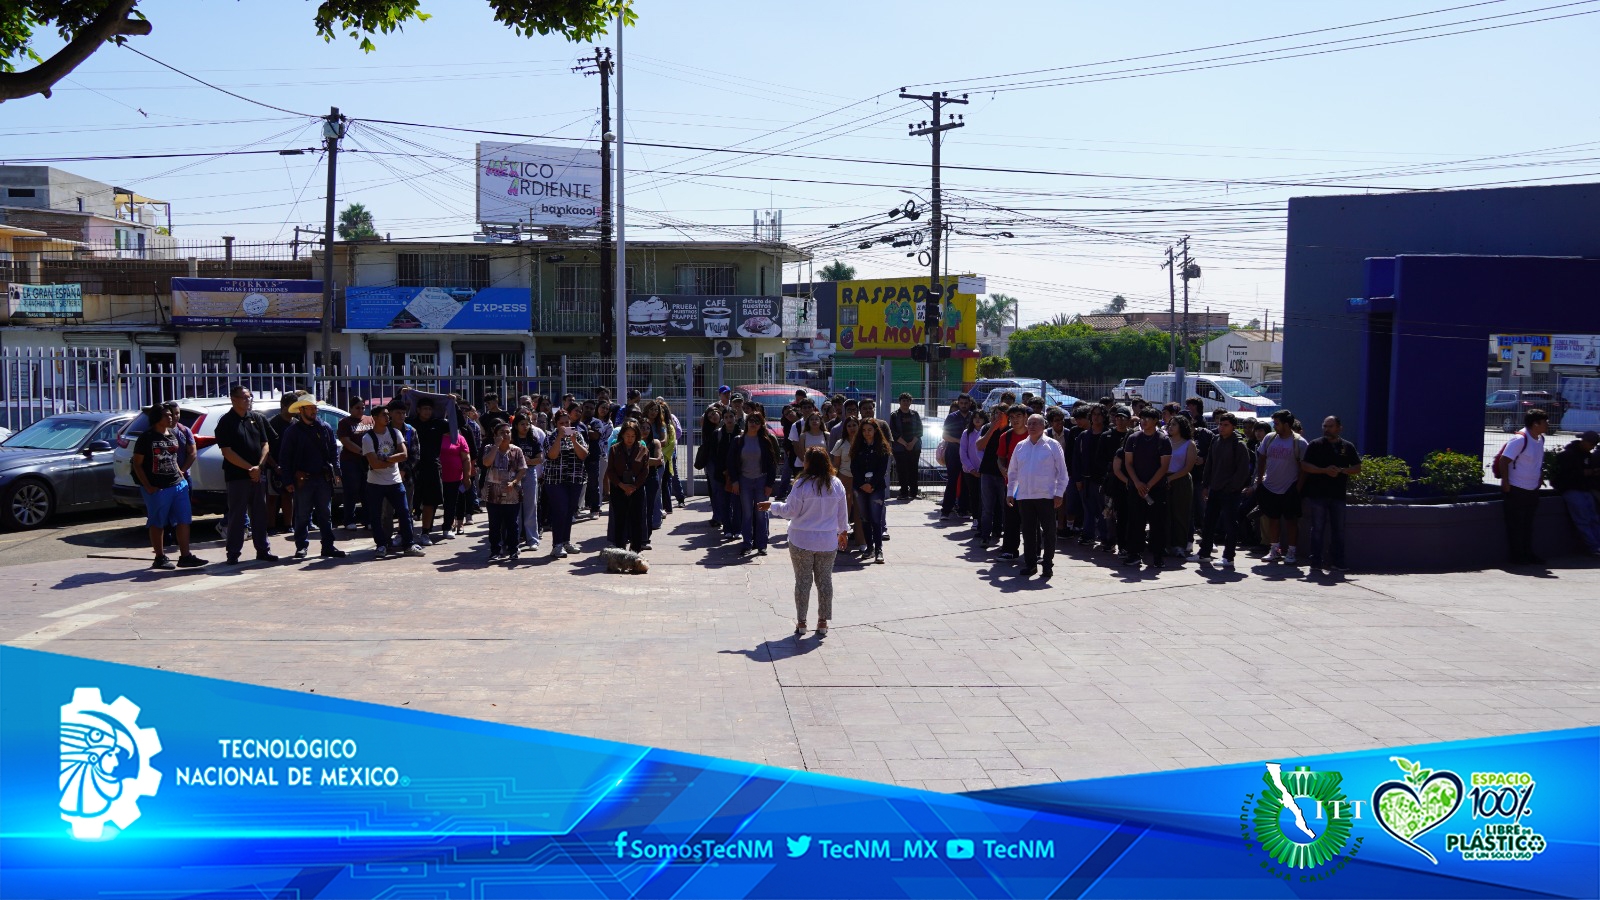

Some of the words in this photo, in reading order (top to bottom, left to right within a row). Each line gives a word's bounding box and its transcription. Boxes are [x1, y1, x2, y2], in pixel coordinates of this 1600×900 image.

[486, 156, 554, 178] MÉXICO
[508, 178, 591, 199] ARDIENTE
[22, 287, 31, 299] LA
[32, 287, 53, 299] GRAN
[55, 285, 81, 299] ESPAÑA
[705, 298, 726, 307] CAFÉ
[742, 308, 772, 316] BAGELS
[857, 325, 878, 343] LA
[883, 325, 957, 343] MOVA
